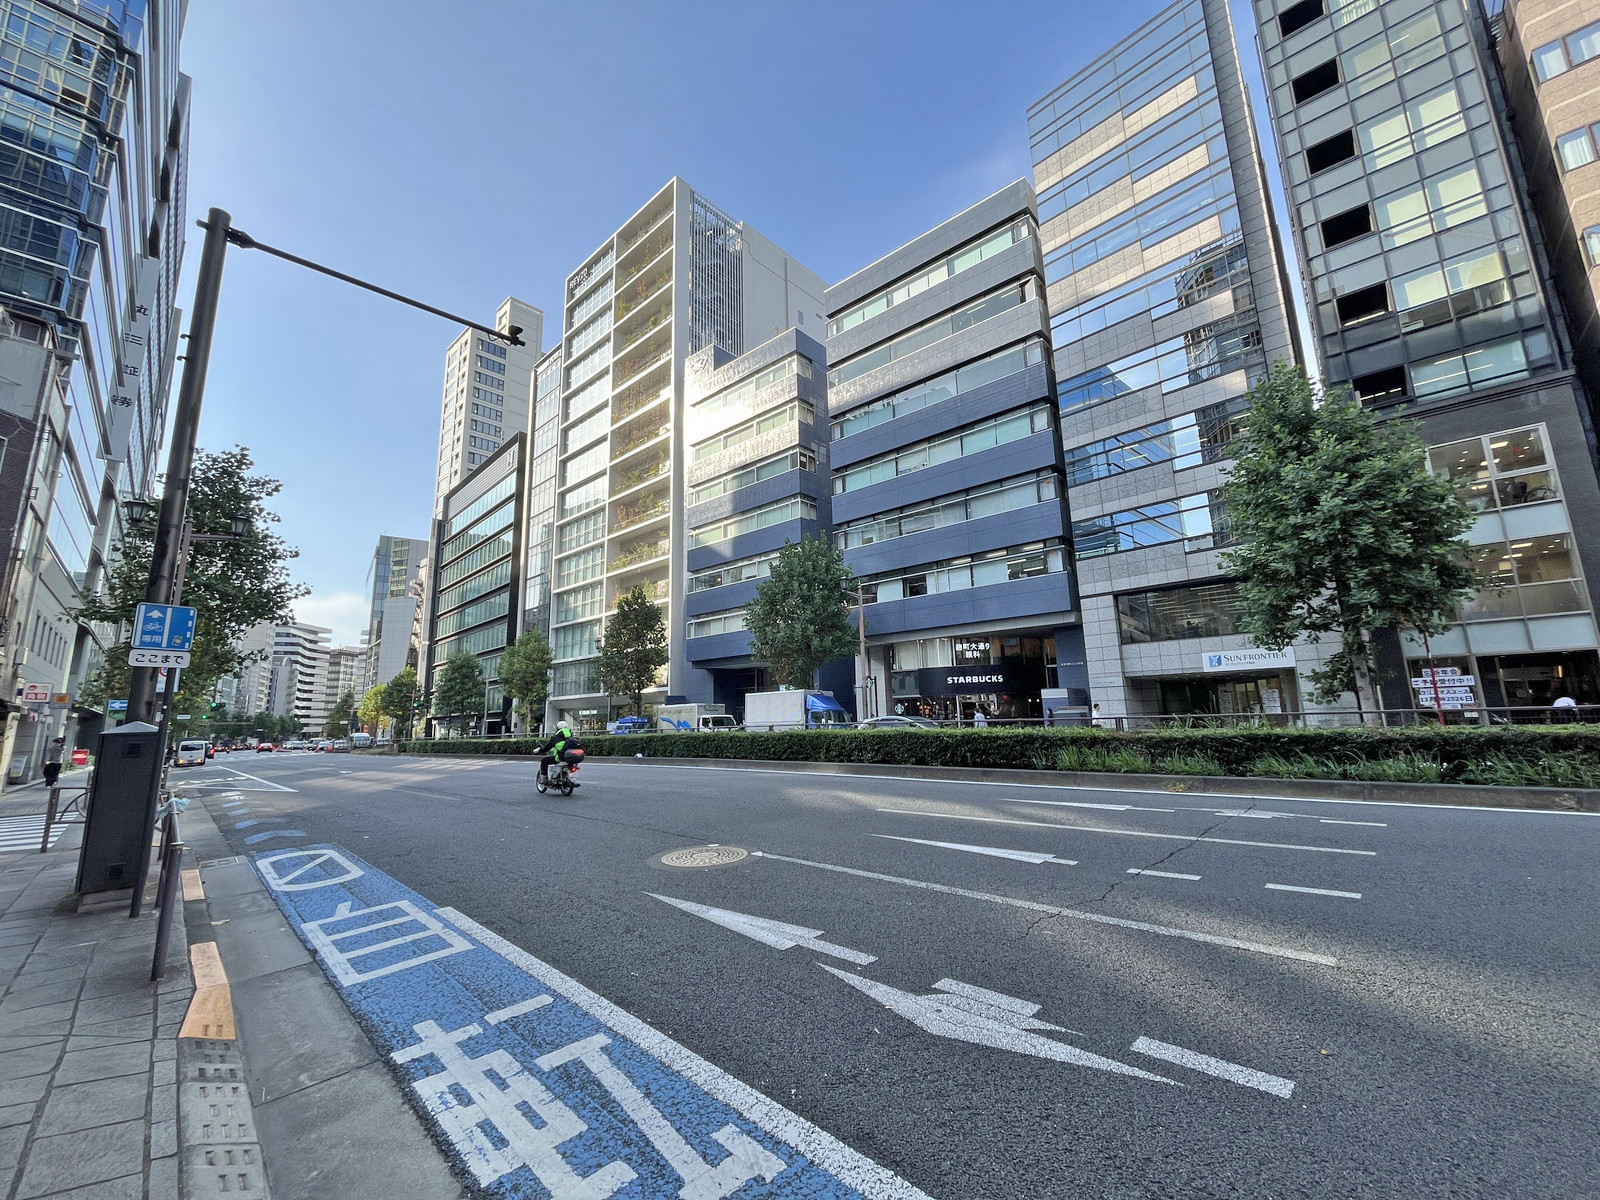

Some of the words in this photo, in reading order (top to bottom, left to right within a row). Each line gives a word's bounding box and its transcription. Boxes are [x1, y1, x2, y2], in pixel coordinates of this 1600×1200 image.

[110, 304, 149, 408] 丸三証券
[141, 634, 162, 644] 専用
[136, 653, 184, 665] ここまで
[1223, 654, 1242, 662] SUN
[1244, 651, 1287, 661] FRONTIER
[947, 675, 1004, 684] STARBUCKS
